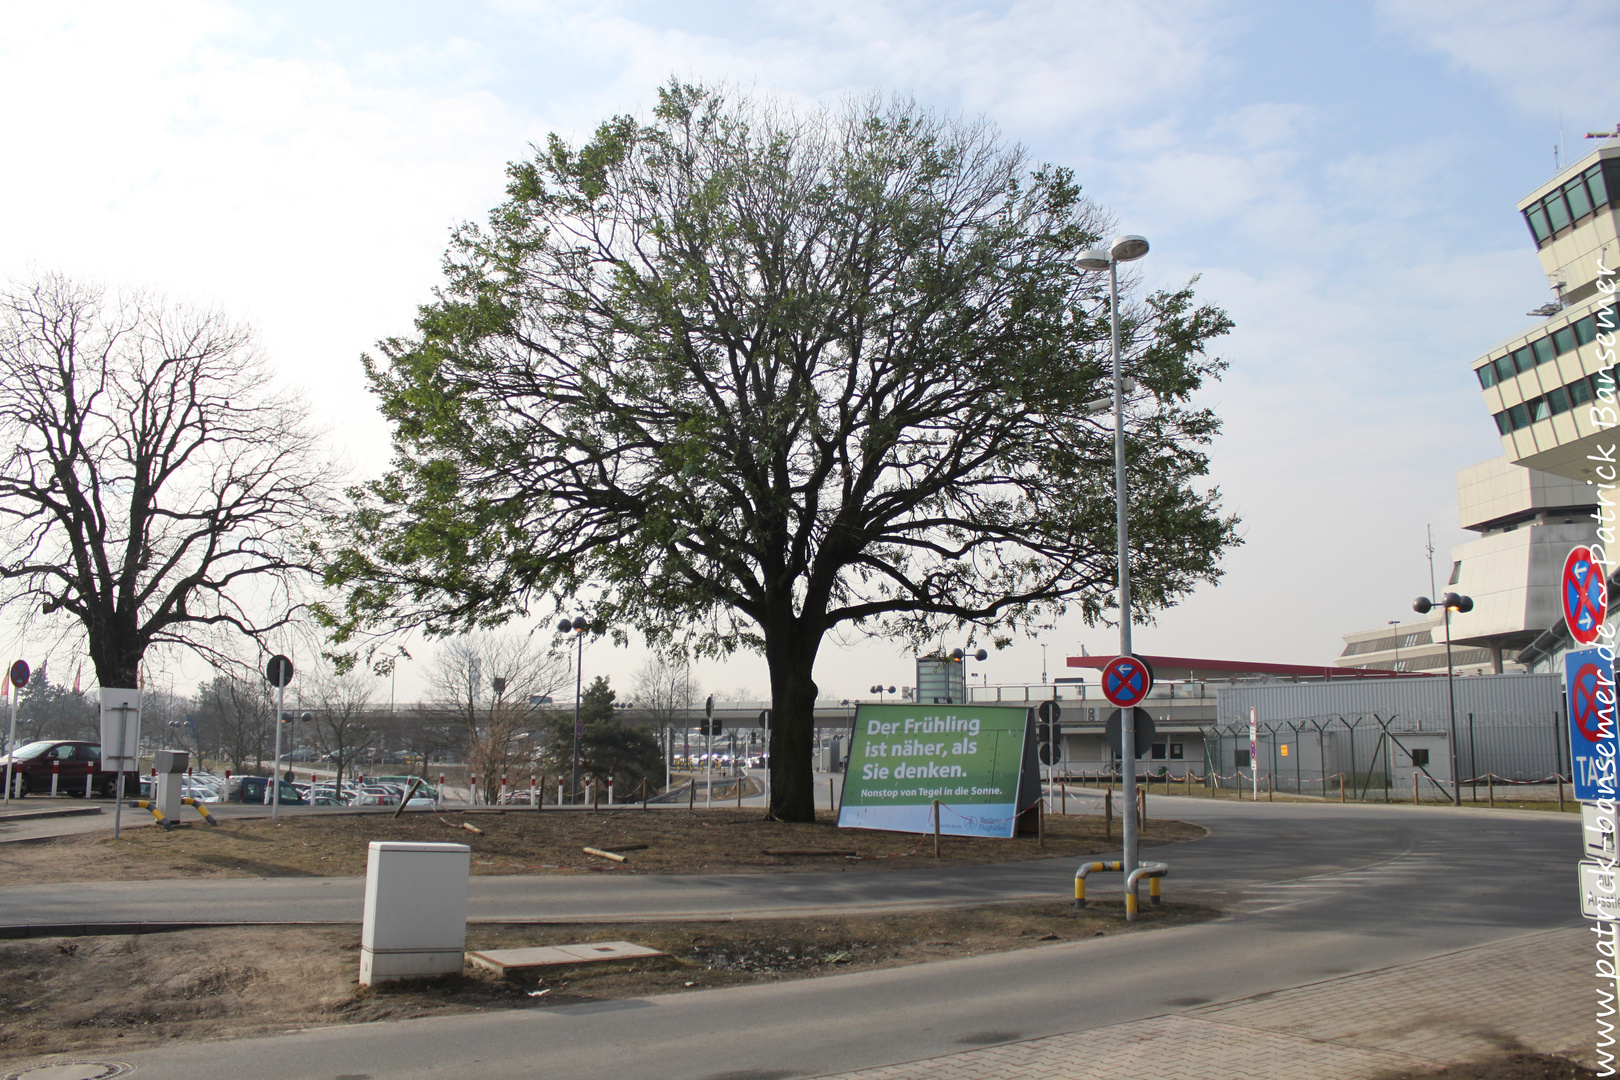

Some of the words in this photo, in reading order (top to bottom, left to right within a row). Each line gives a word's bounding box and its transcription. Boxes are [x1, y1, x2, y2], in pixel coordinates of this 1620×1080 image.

[867, 720, 900, 735] Der
[904, 715, 980, 736] Frühling
[865, 741, 888, 757] ist
[891, 739, 948, 758] näher,
[952, 737, 977, 755] als
[862, 763, 890, 780] Sie
[894, 761, 968, 779] denken.
[1576, 756, 1618, 788] TAXI
[861, 788, 898, 798] Nonstop
[919, 787, 942, 798] Tegel
[944, 787, 953, 796] in
[955, 786, 969, 795] die
[971, 786, 1003, 795] Sonne.
